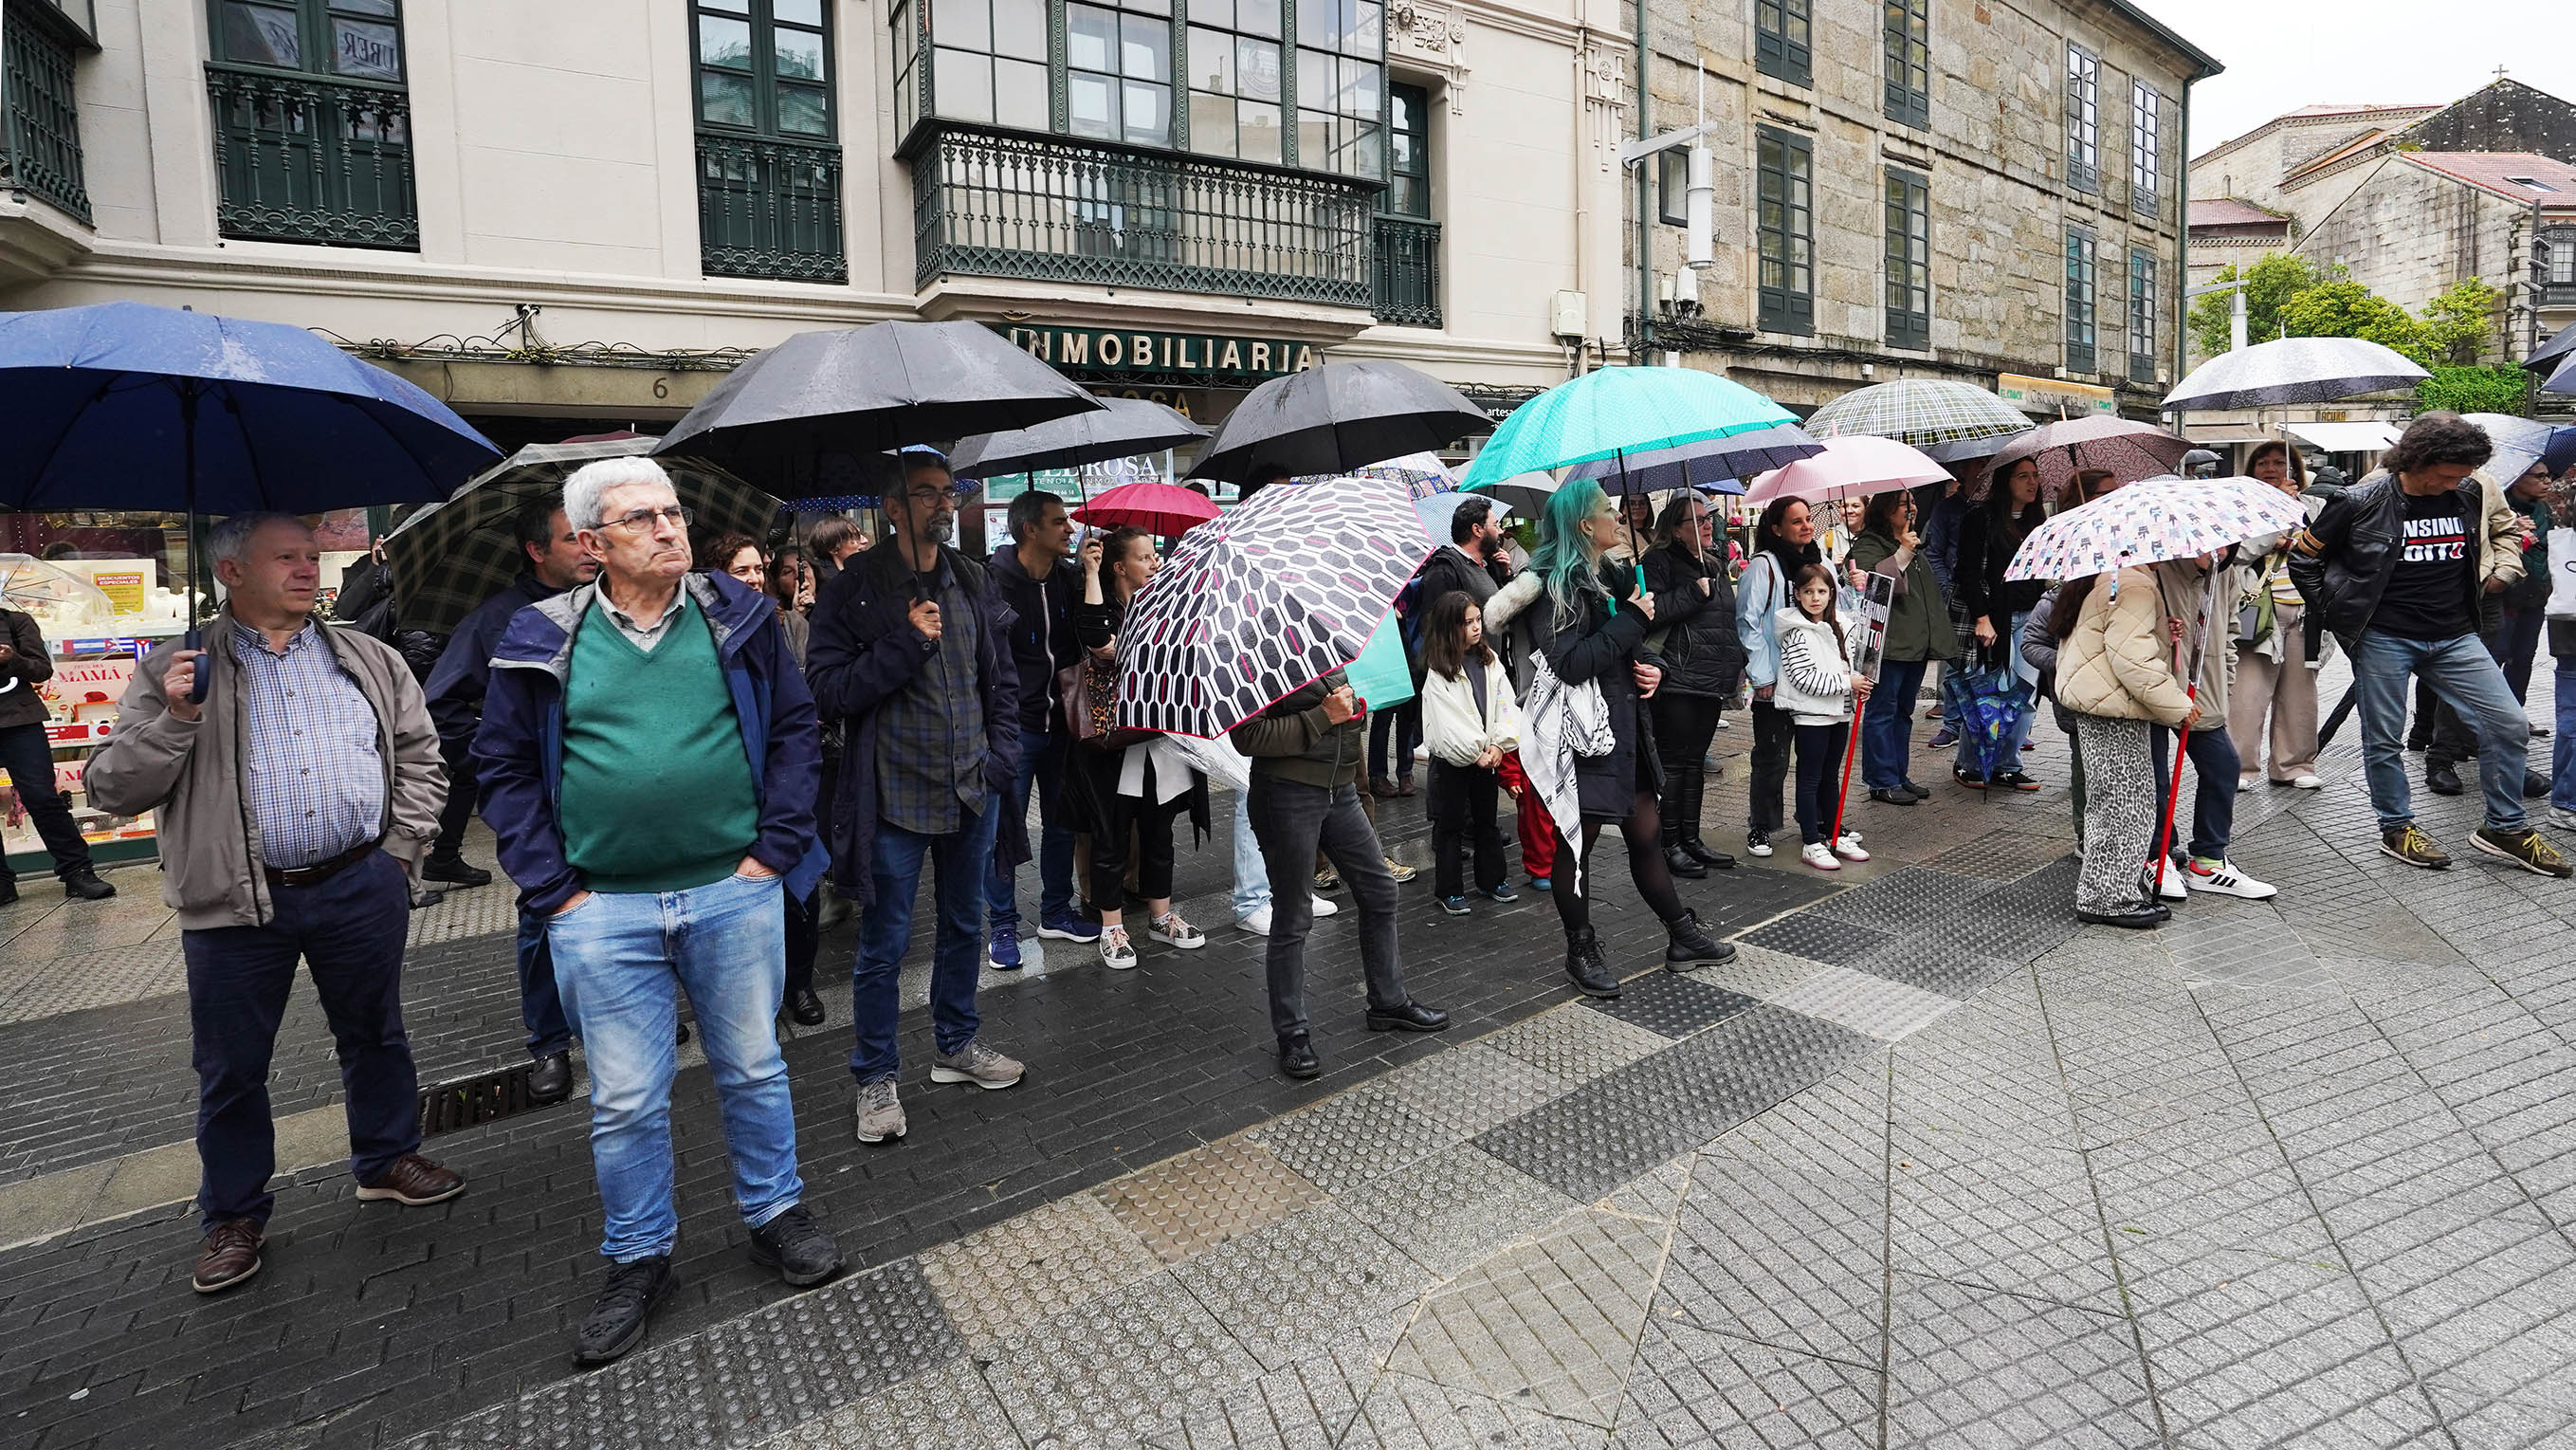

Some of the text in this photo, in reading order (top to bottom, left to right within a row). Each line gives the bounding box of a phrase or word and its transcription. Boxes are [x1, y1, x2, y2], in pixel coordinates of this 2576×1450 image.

[653, 377, 667, 398] 6
[1024, 455, 1159, 477] DROSA
[2397, 541, 2466, 561] OITO
